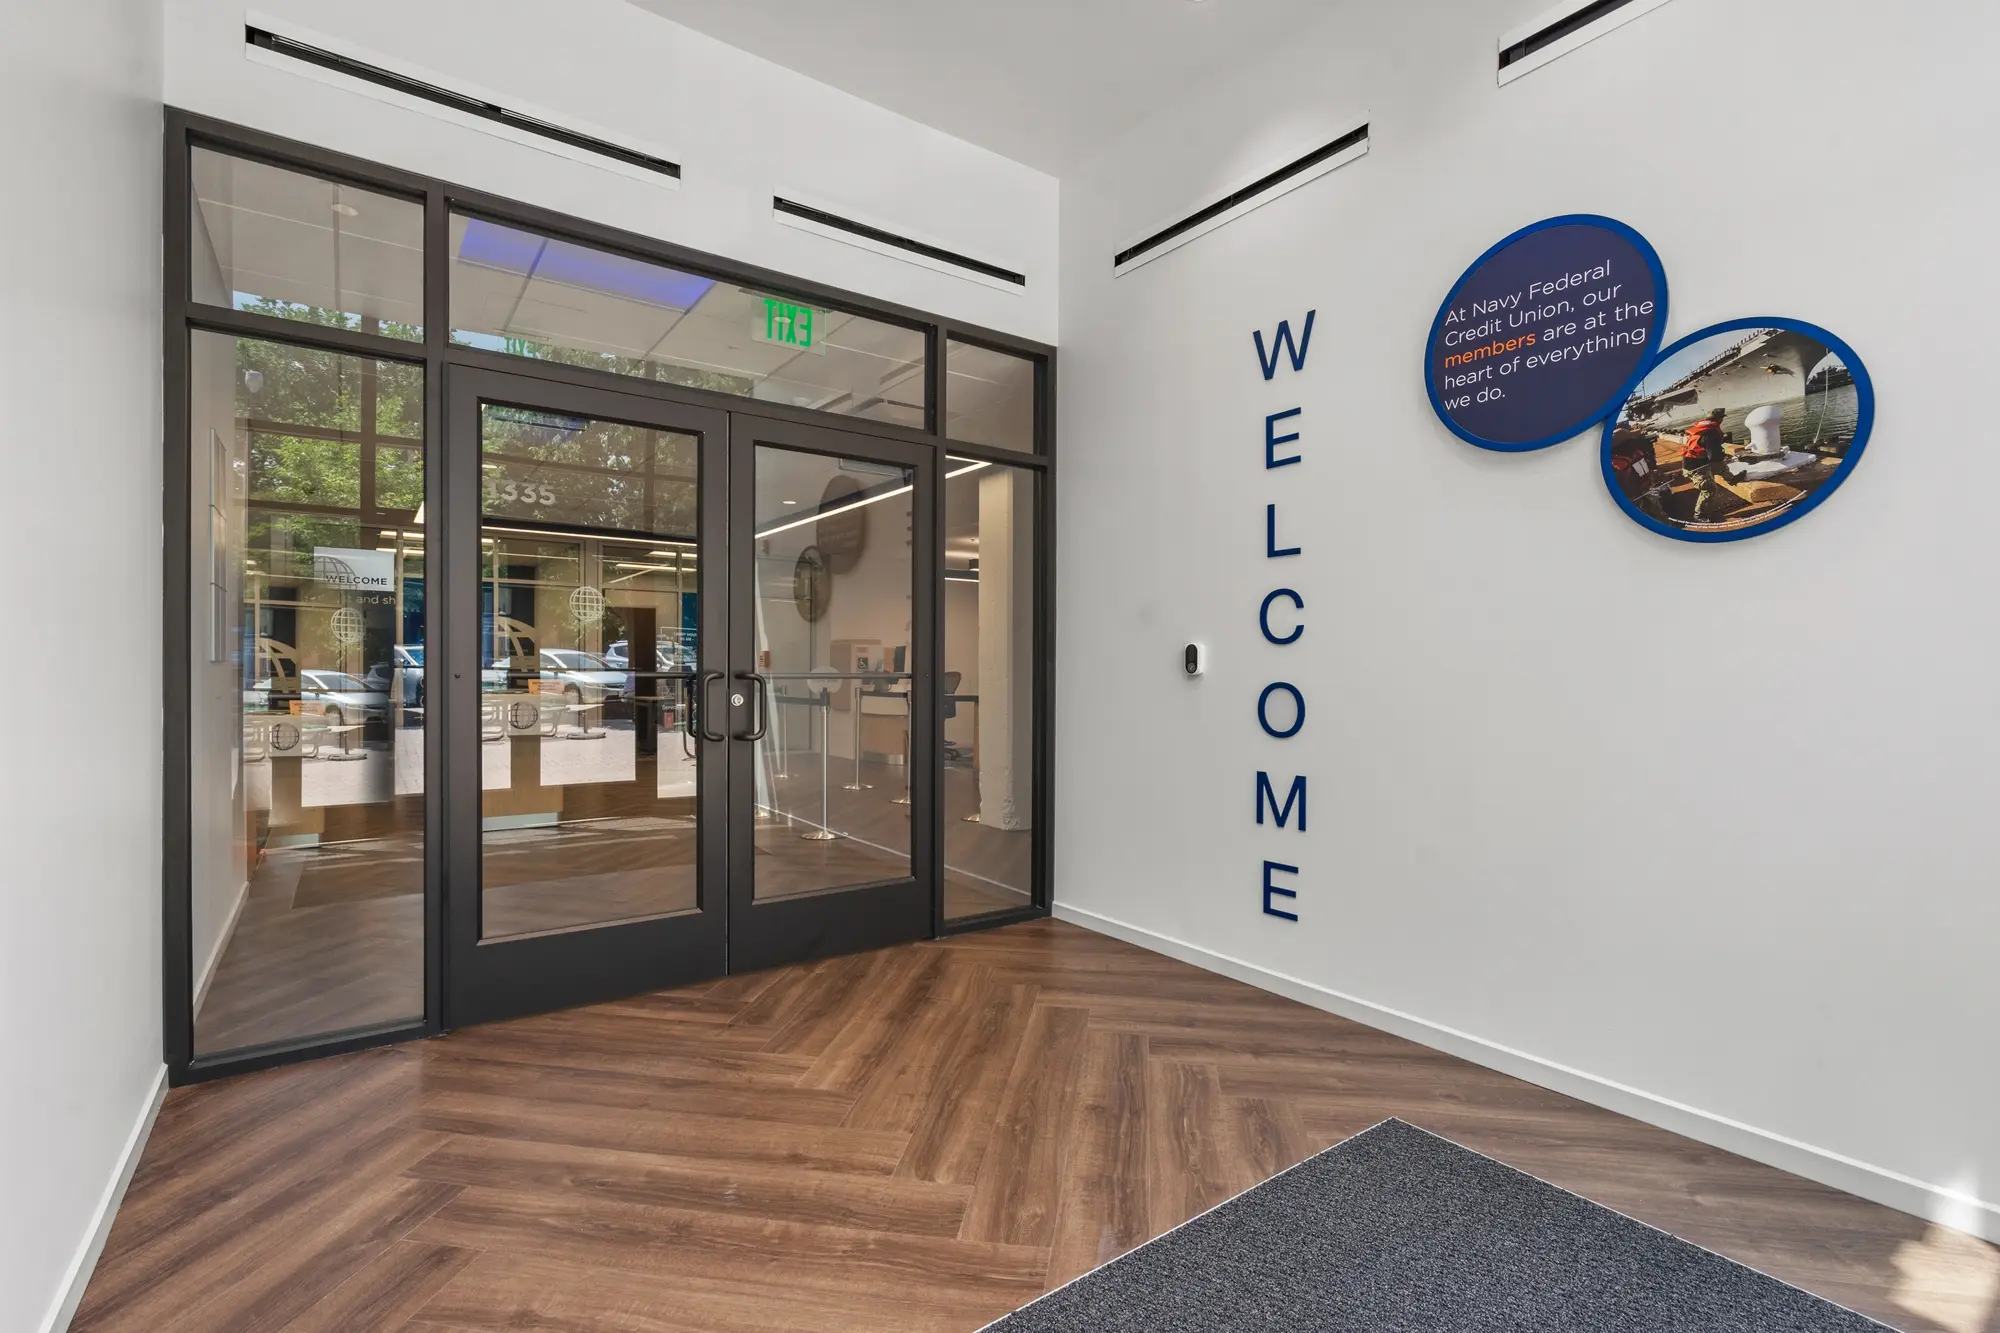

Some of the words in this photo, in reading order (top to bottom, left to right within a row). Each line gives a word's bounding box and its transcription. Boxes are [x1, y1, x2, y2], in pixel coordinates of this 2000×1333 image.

[1444, 309, 1466, 326] At
[1472, 291, 1522, 318] Navy
[1529, 259, 1610, 300] Federal
[1445, 318, 1502, 347] Credit
[1509, 300, 1576, 328] Union,
[1582, 284, 1622, 307] our
[1444, 333, 1536, 369] members
[1543, 322, 1577, 343] are
[1584, 311, 1607, 330] at
[1614, 301, 1654, 322] the
[1444, 364, 1493, 390] heart
[1499, 356, 1521, 376] of
[1526, 327, 1647, 369] everything
[1444, 394, 1471, 411] we
[1476, 386, 1506, 404] do.
[487, 479, 556, 505] 1335
[325, 575, 388, 586] WELCOME
[356, 595, 379, 604] and
[1252, 309, 1317, 922] WELCOME
